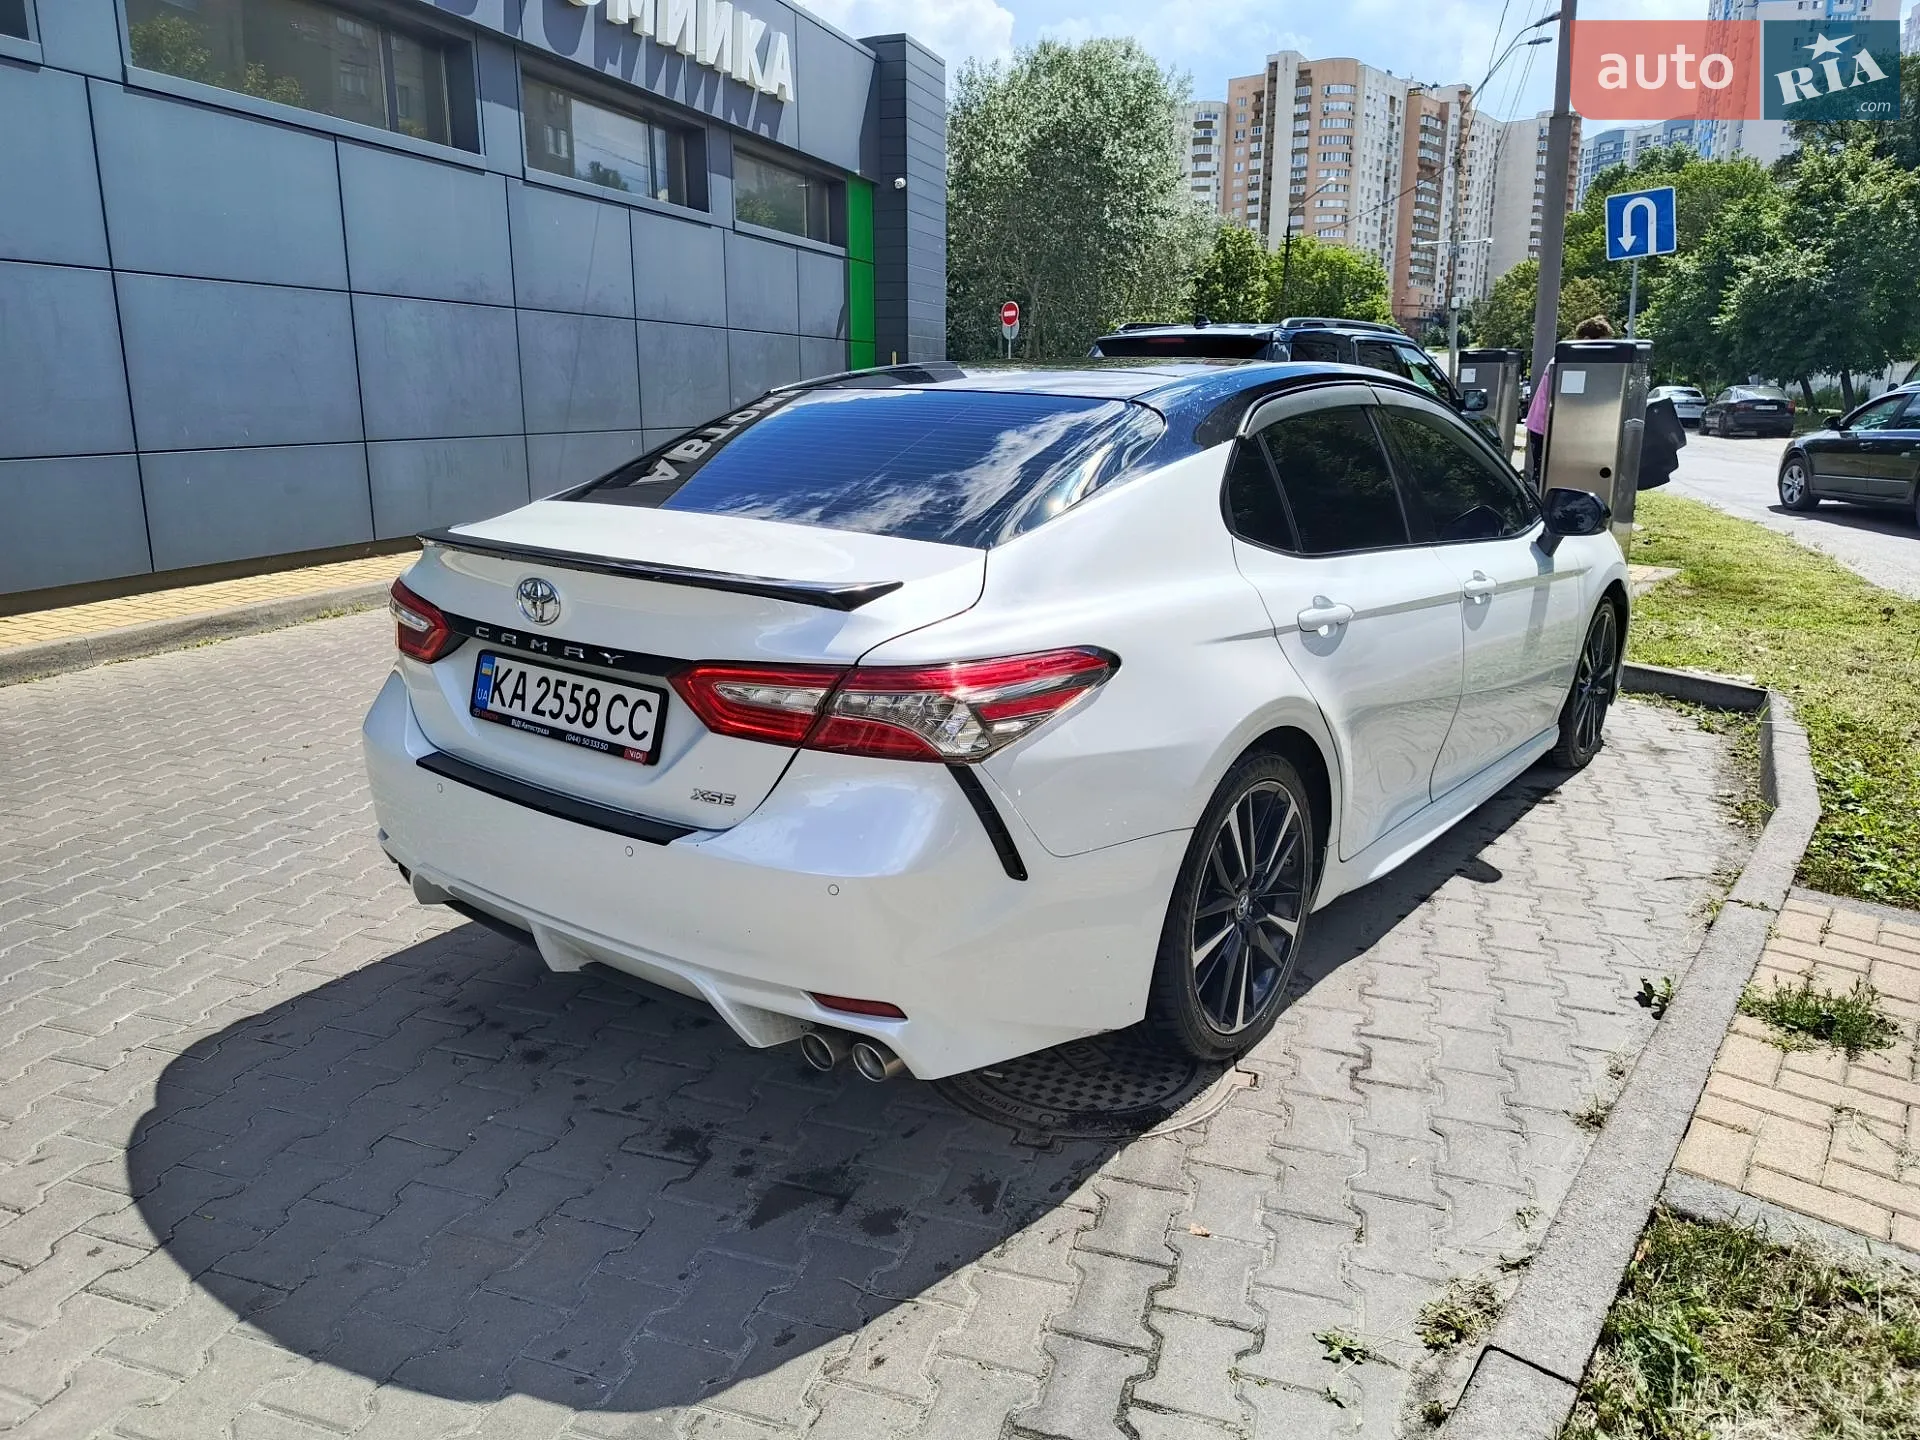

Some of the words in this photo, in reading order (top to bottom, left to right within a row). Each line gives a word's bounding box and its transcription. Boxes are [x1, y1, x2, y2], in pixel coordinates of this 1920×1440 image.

[475, 626, 624, 664] CAMRY
[477, 687, 488, 701] UA
[489, 665, 527, 712] KA
[531, 676, 601, 729] 2558
[605, 693, 652, 741] CC
[690, 788, 737, 806] XSE
